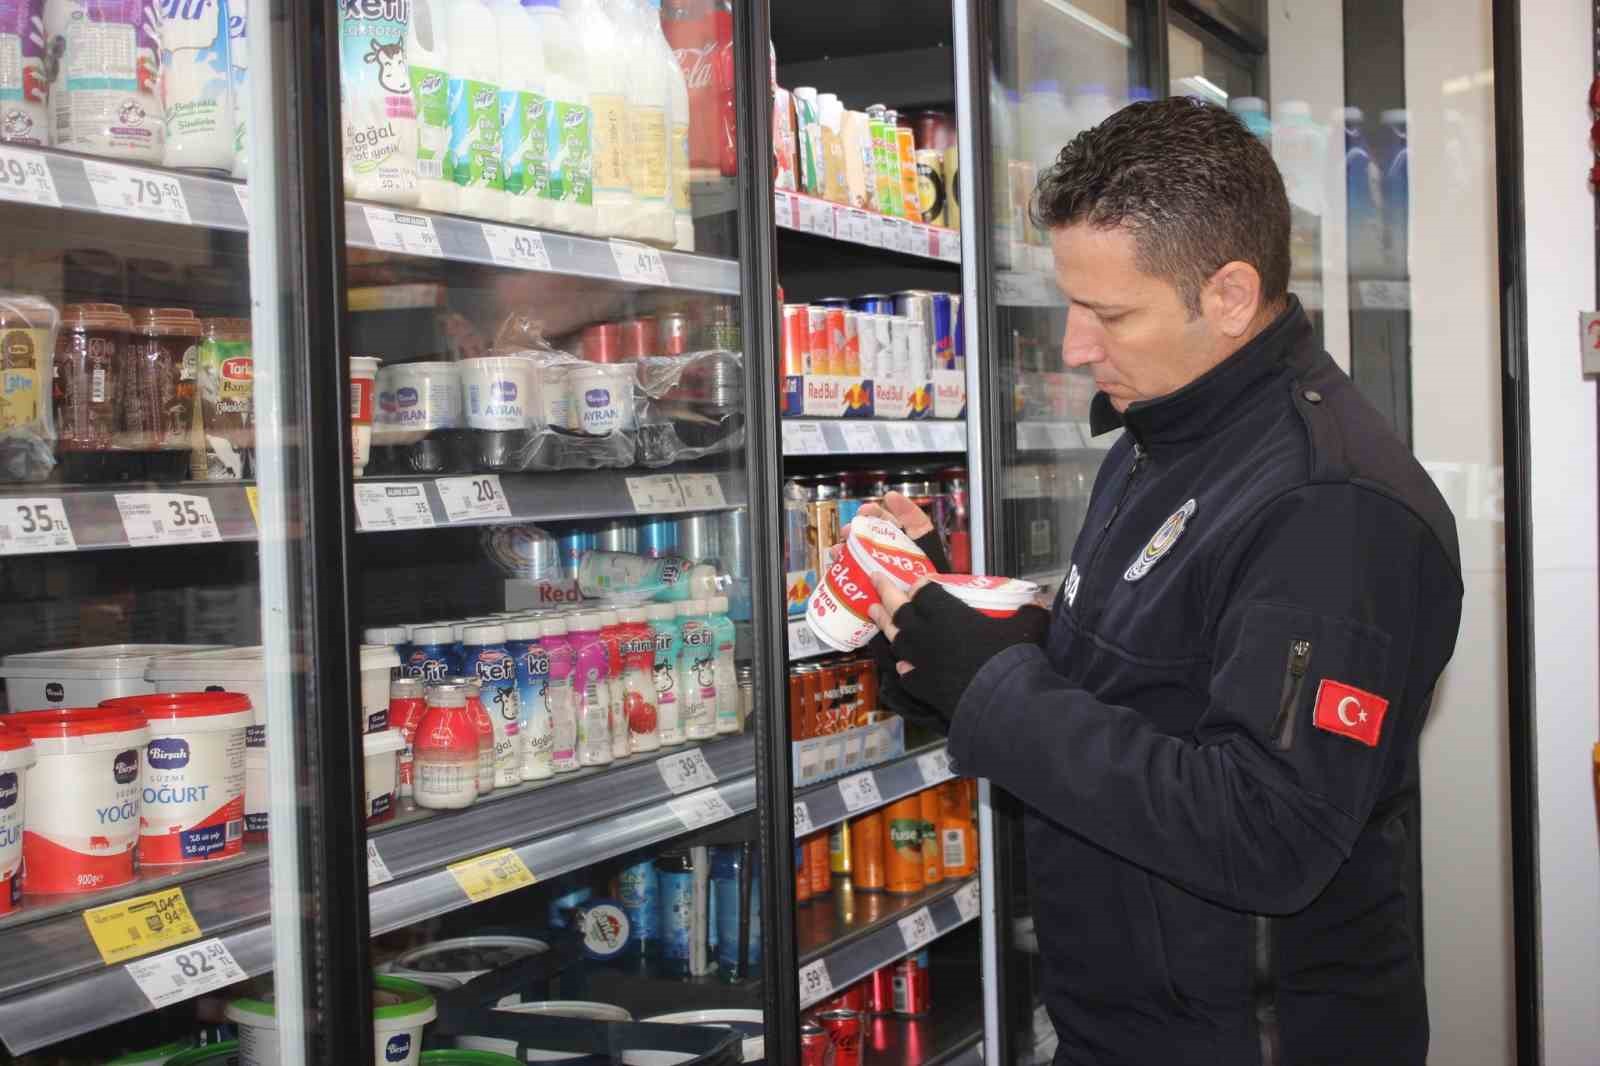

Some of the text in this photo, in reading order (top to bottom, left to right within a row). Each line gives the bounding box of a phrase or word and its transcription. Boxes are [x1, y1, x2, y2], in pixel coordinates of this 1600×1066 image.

[472, 479, 495, 502] 20
[16, 504, 53, 532] 35
[168, 500, 200, 526] 35
[539, 582, 579, 603] Red
[142, 784, 209, 804] OĞURT
